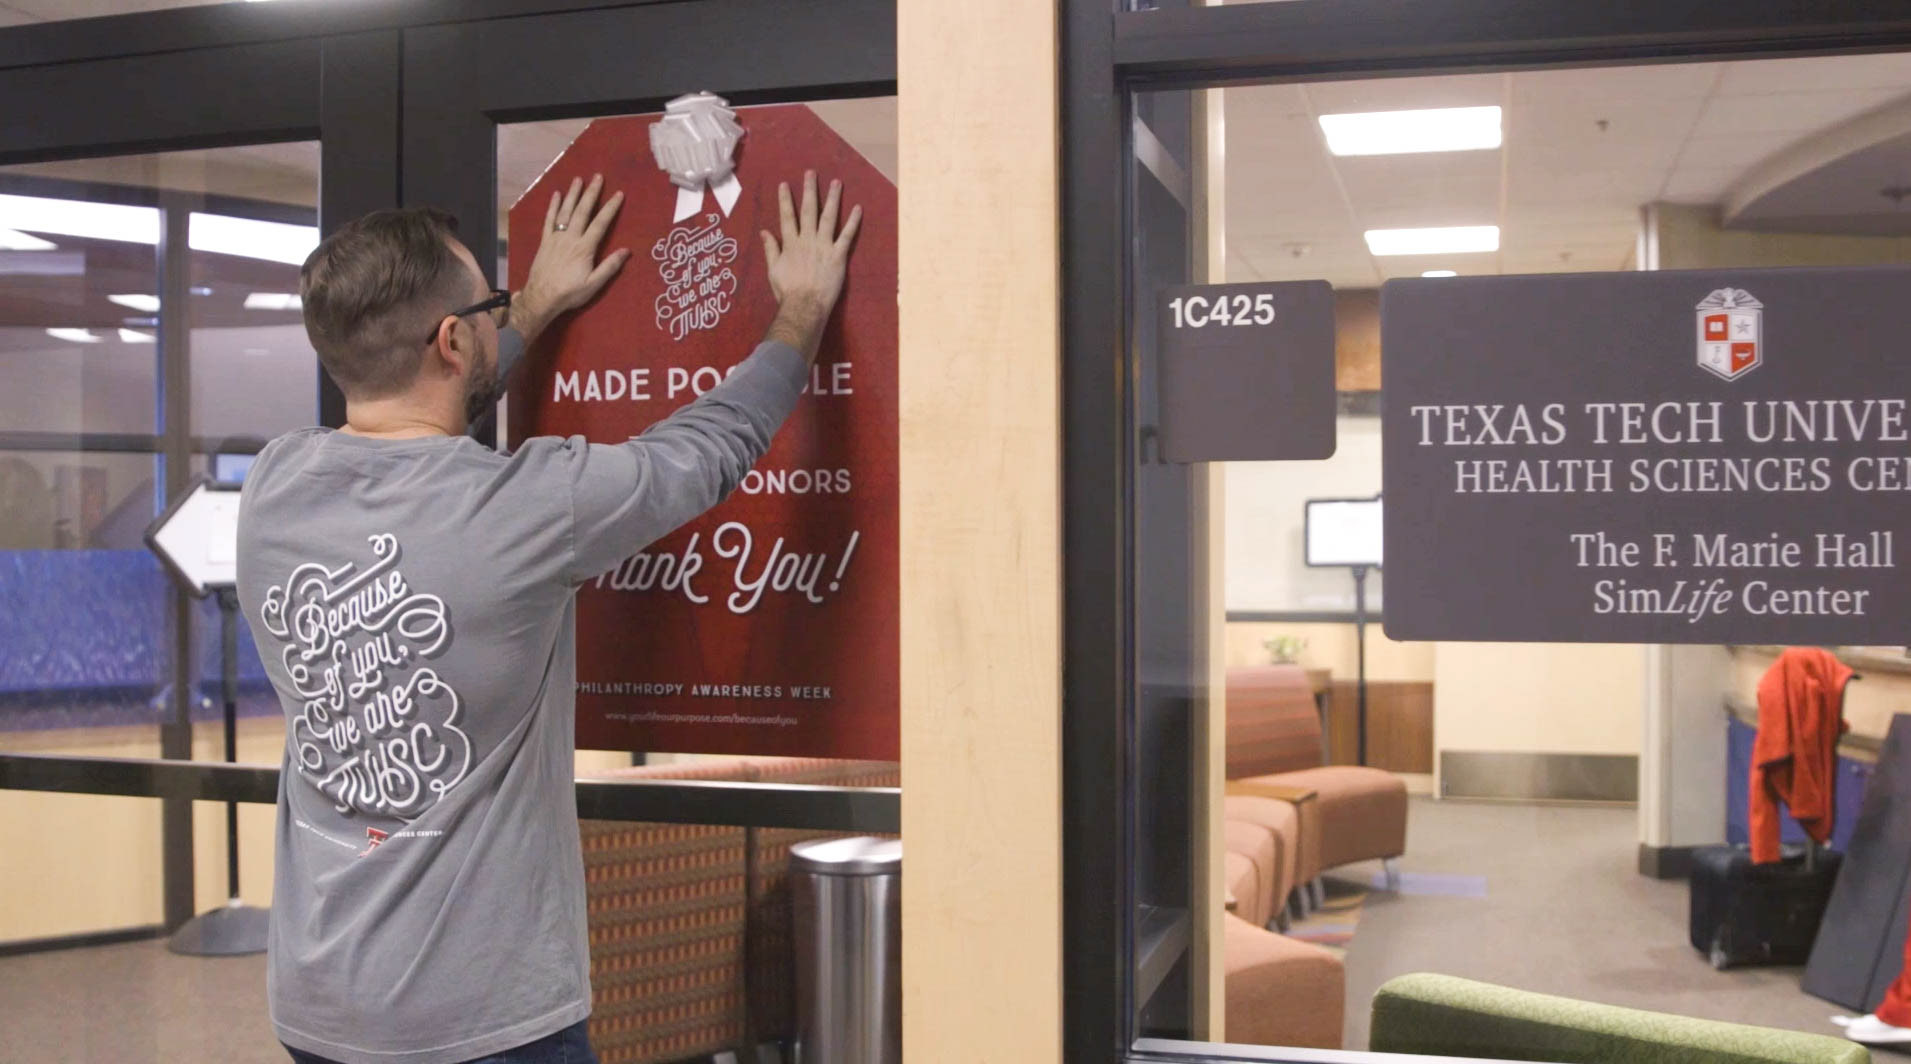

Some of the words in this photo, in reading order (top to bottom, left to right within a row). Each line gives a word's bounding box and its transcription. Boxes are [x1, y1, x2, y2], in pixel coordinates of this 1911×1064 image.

[681, 256, 697, 288] of
[677, 289, 698, 309] we
[699, 275, 722, 297] are
[1169, 294, 1275, 328] 1C425
[554, 368, 650, 402] MADE
[668, 362, 853, 400] POLE
[1411, 403, 1567, 445] TEXAS
[1585, 401, 1723, 443] TECH
[1744, 399, 1908, 442] UNIVE
[741, 469, 852, 495] ONORS
[1454, 459, 1613, 493] HEALTH
[1629, 457, 1831, 492] SCIENCES
[1848, 457, 1911, 491] CE
[597, 532, 709, 604] ank
[713, 521, 860, 614] You!
[1570, 531, 1640, 567] The
[1653, 534, 1678, 567] F.
[1692, 532, 1801, 567] Marie
[1815, 531, 1895, 567] Hall
[293, 569, 408, 662] Because
[1594, 578, 1733, 624] SimLife
[1742, 580, 1870, 615] Center
[323, 638, 348, 711] of
[691, 684, 783, 698] AWARENESS
[790, 685, 832, 699] WEEK
[328, 716, 361, 754] we
[363, 684, 413, 735] are
